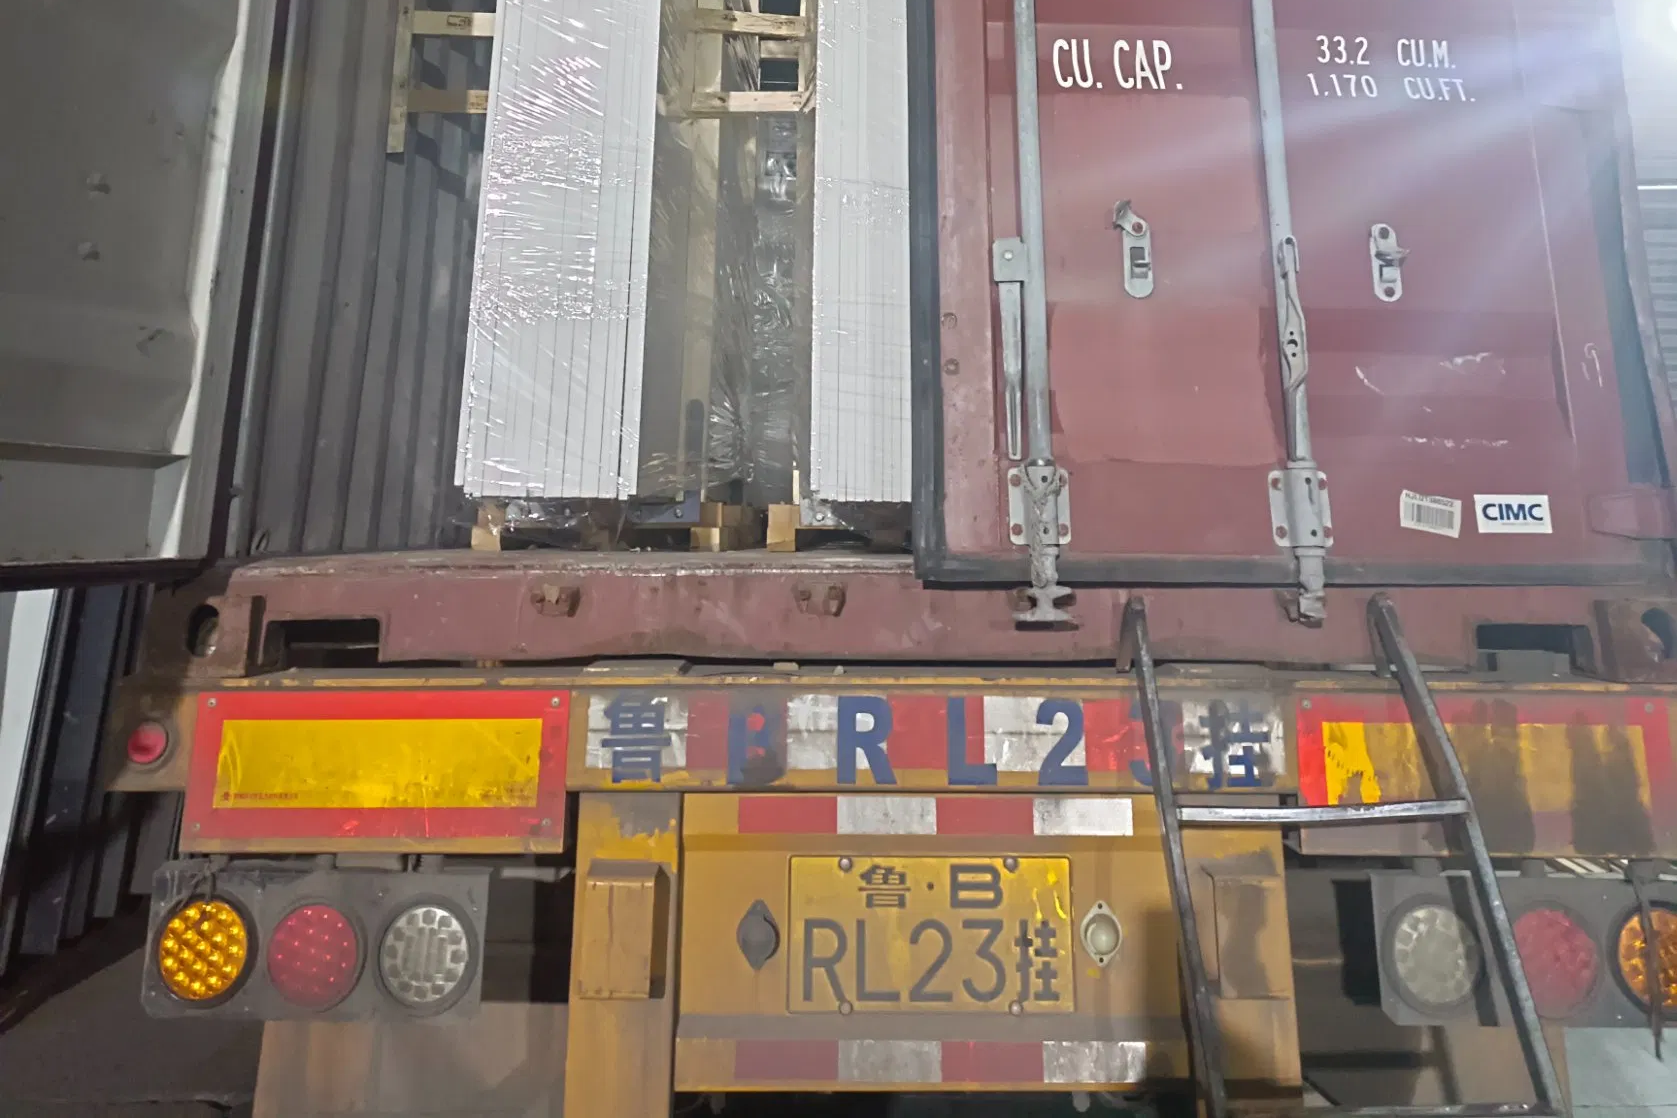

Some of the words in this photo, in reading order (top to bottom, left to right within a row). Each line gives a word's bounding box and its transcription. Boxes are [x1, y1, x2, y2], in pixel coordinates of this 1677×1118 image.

[1053, 39, 1103, 89] CU.
[1114, 39, 1183, 90] CAP.
[1316, 35, 1370, 65] 33.2
[1397, 38, 1456, 69] CU.M.
[1403, 76, 1476, 101] CU.FT.
[1482, 503, 1544, 522] CIMC
[803, 918, 1061, 1003] RL23挂
